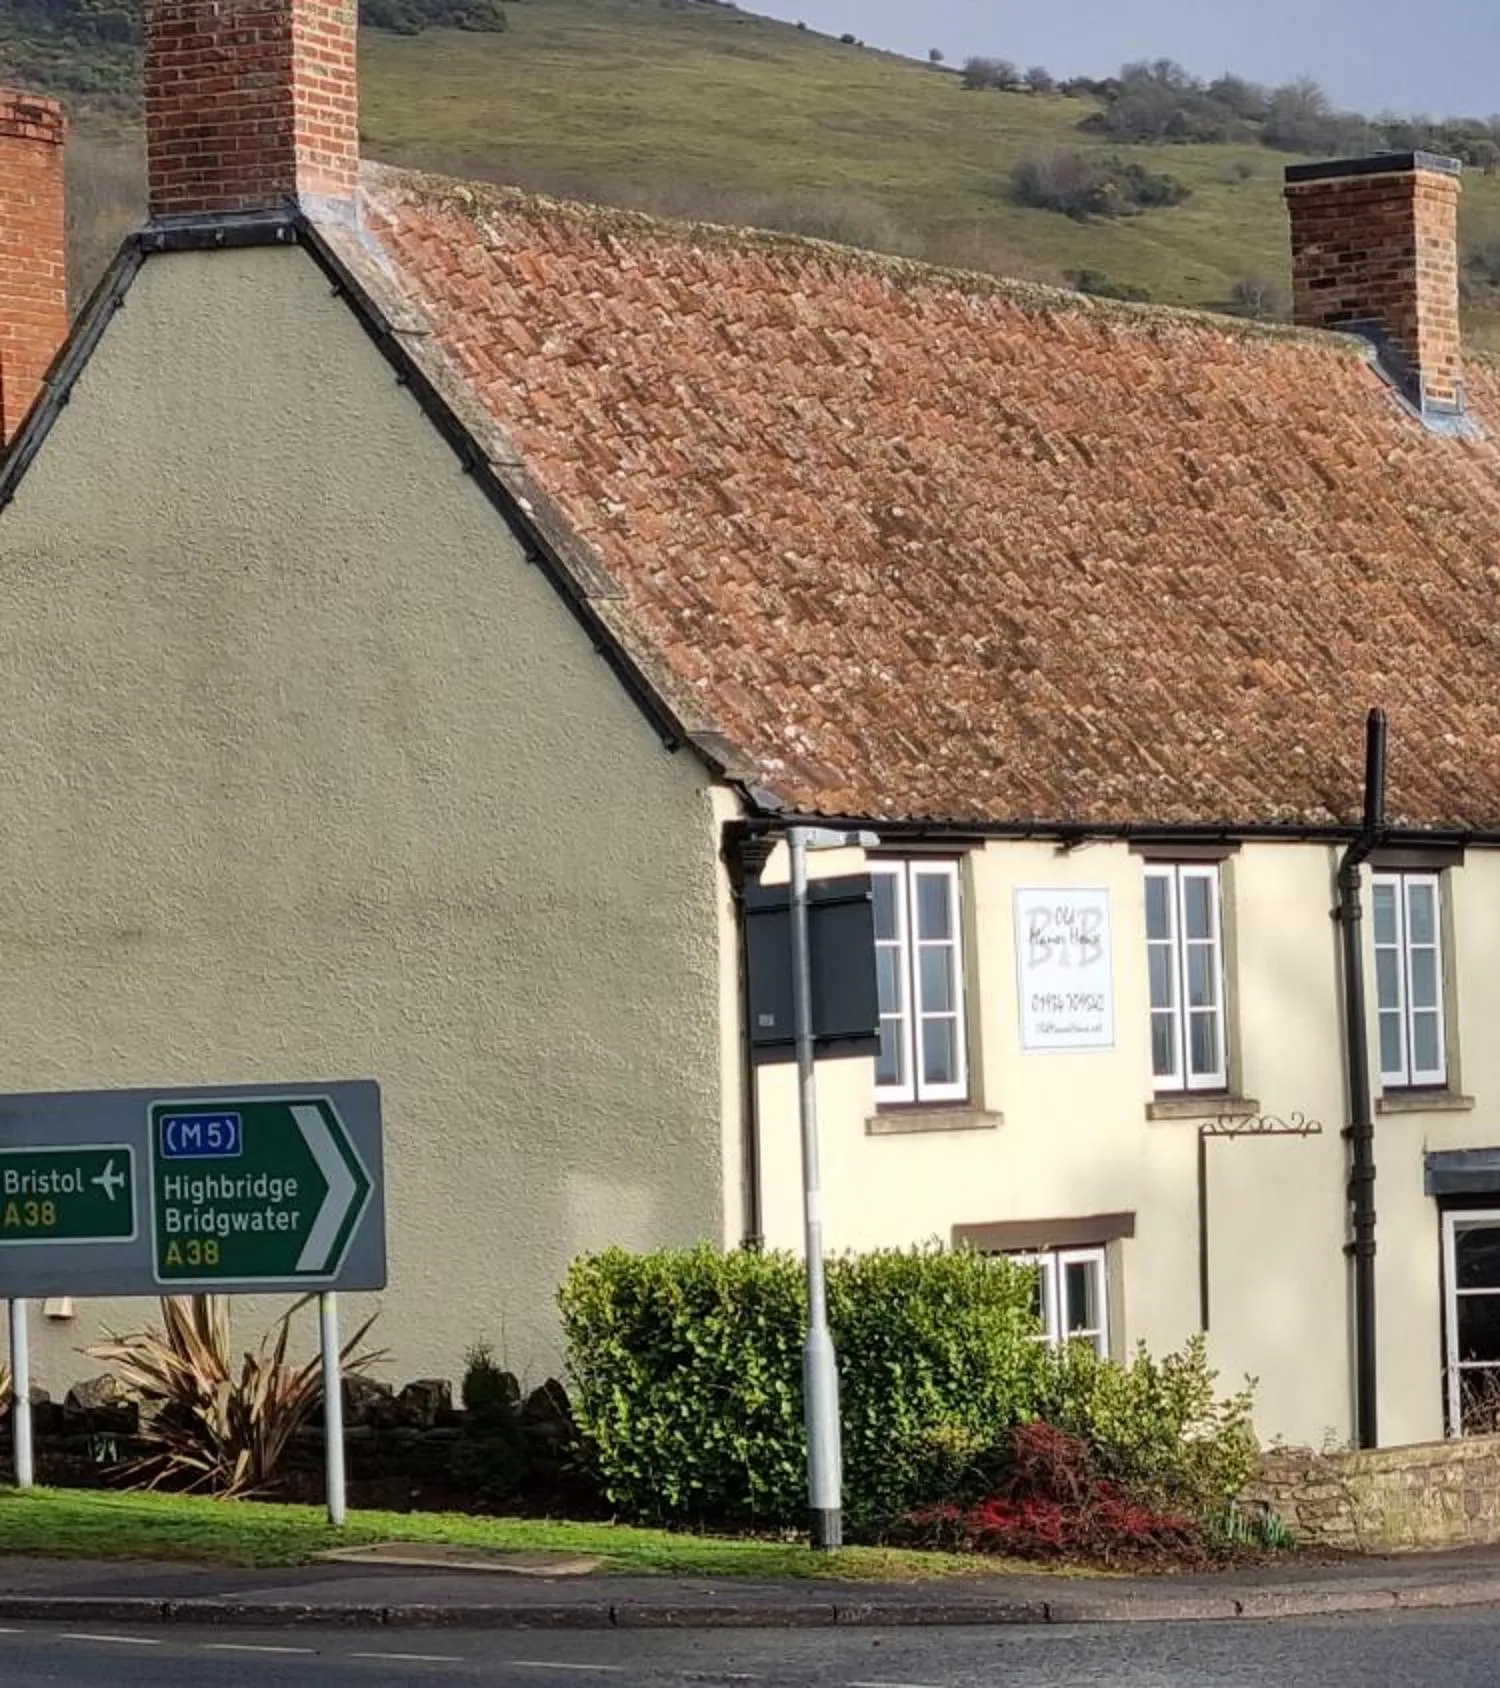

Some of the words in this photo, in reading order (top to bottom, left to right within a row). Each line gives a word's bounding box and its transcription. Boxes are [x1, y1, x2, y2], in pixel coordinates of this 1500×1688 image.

[1055, 906, 1075, 926] Old
[165, 1119, 236, 1151] (M5)
[4, 1168, 85, 1194] Bristol
[164, 1172, 298, 1204] Highbridge
[4, 1203, 57, 1227] A38
[165, 1206, 300, 1237] Bridgwater
[165, 1240, 219, 1266] A38
